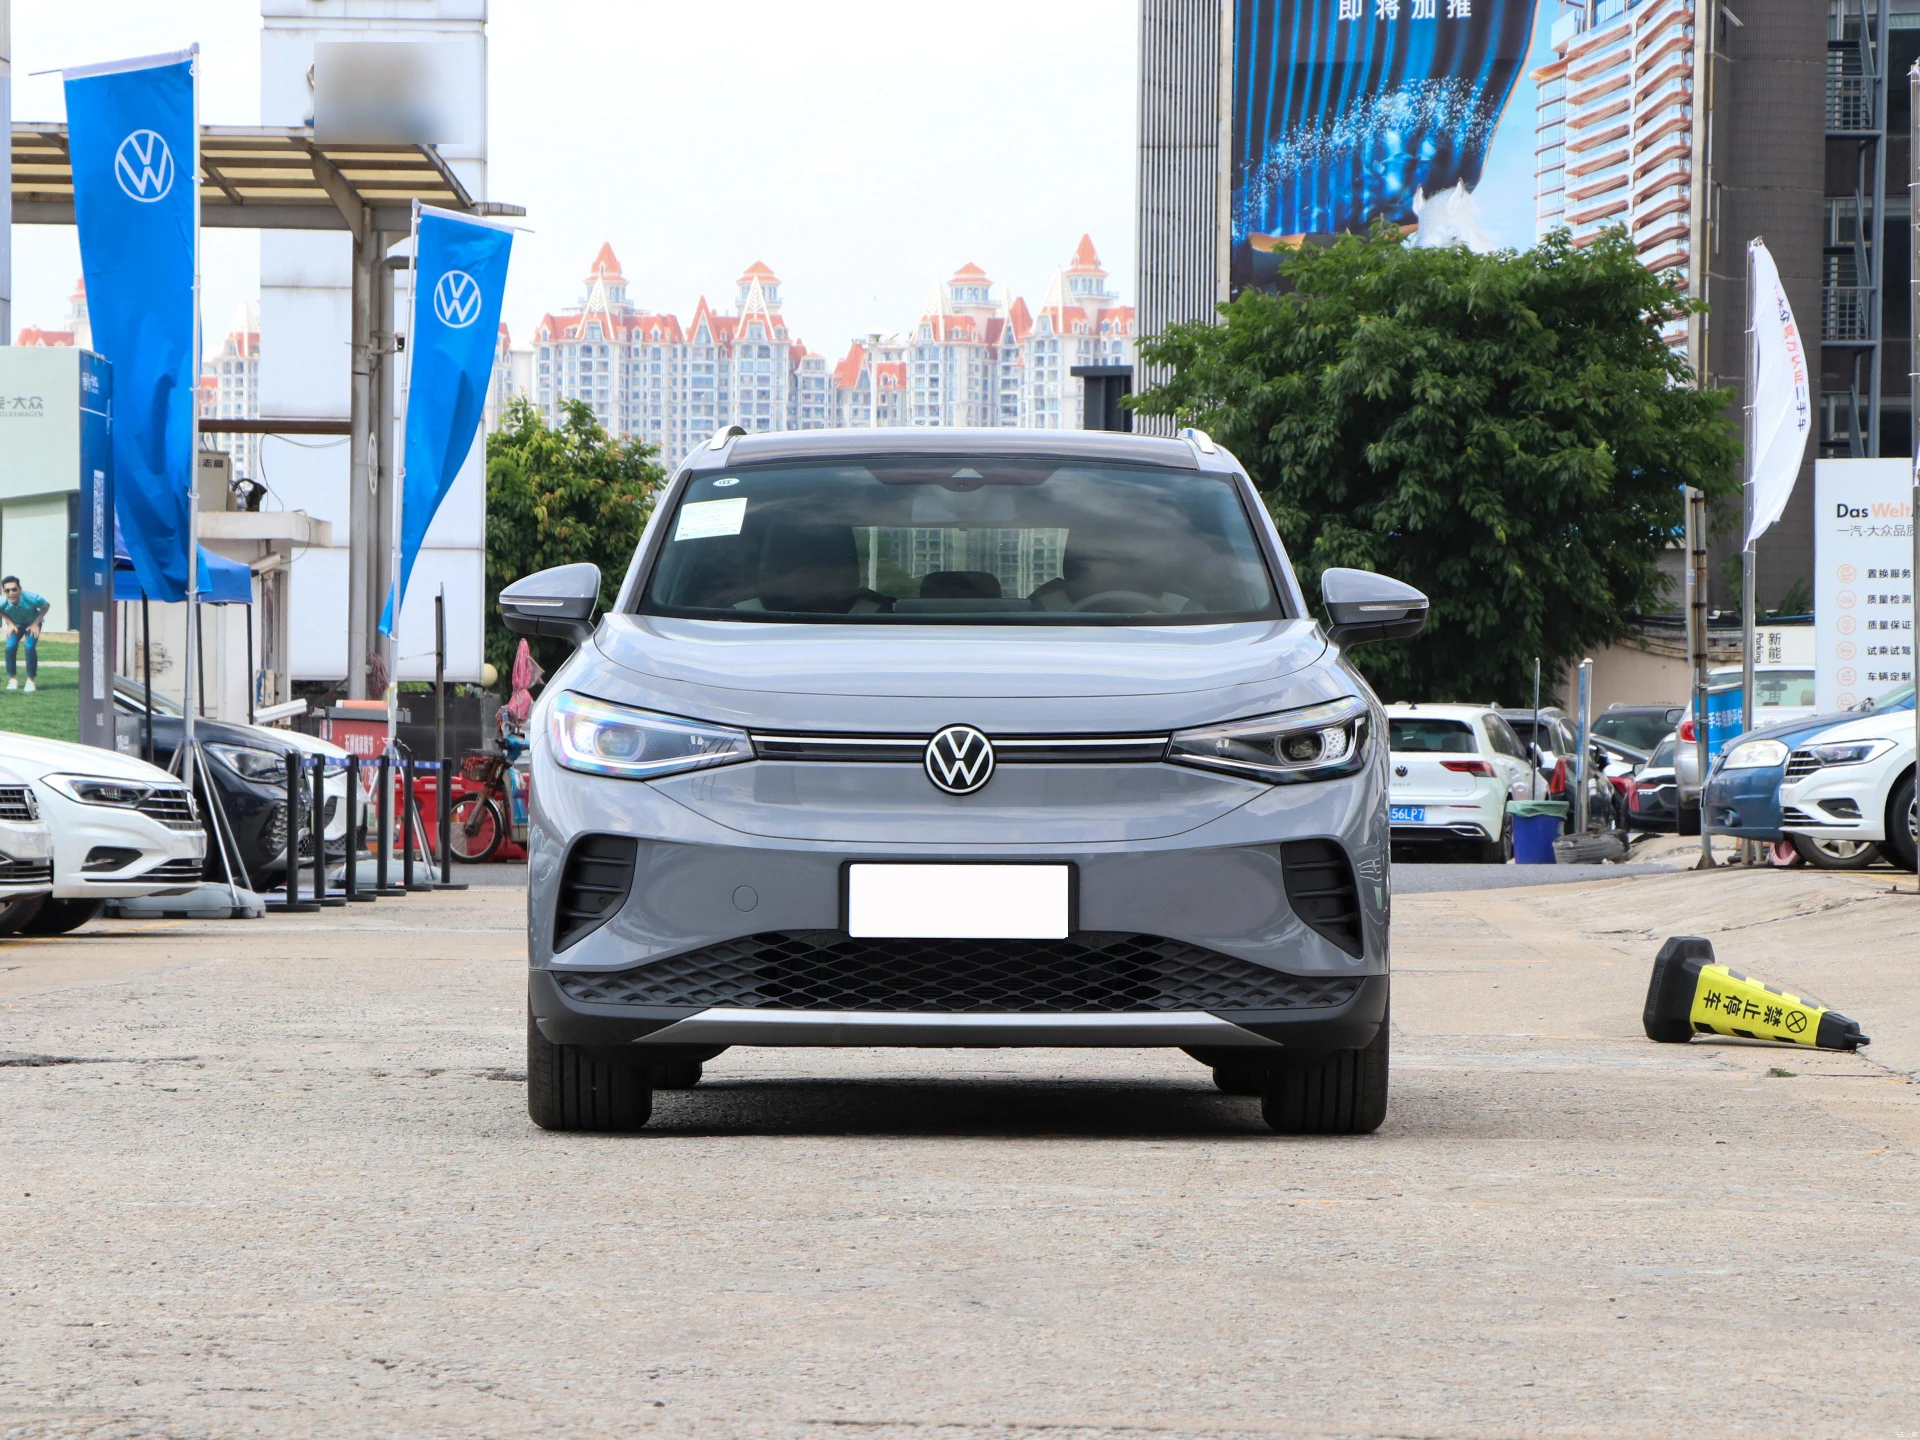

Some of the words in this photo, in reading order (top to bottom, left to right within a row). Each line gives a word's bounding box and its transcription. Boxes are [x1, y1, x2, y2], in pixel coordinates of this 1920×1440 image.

[1338, 0, 1472, 20] 即将加推
[1836, 503, 1869, 518] Das
[1871, 502, 1913, 518] Welt
[1867, 568, 1912, 579] 置换服务
[1867, 594, 1912, 605] 质量检测
[1867, 620, 1912, 630] 质量保证
[1754, 632, 1764, 664] Parking
[1867, 645, 1912, 656] 试乘试驾
[1867, 671, 1912, 682] 车辆定制
[1391, 807, 1425, 820] 56LP7
[1703, 990, 1783, 1027] 禁止停车
